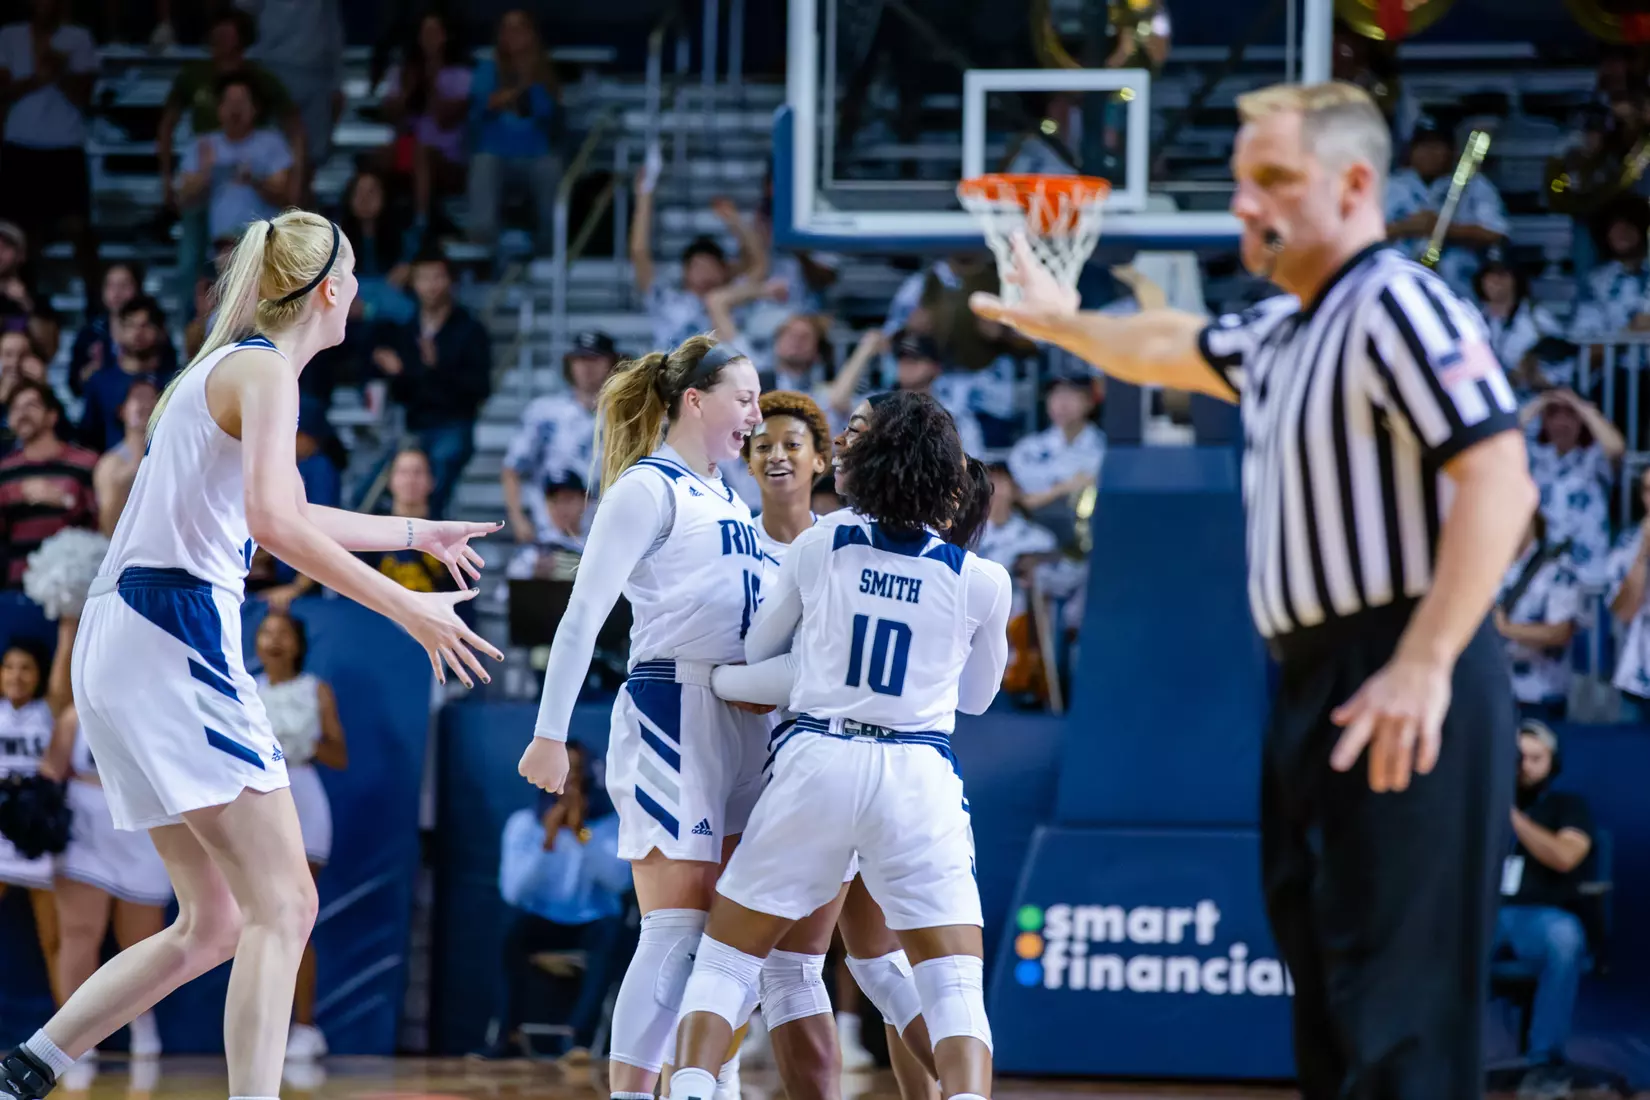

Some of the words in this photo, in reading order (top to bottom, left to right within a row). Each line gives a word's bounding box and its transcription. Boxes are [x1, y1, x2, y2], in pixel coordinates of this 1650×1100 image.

[717, 519, 763, 562] RIC
[859, 568, 922, 604] SMITH
[845, 613, 913, 697] 10
[1044, 899, 1221, 945] smart
